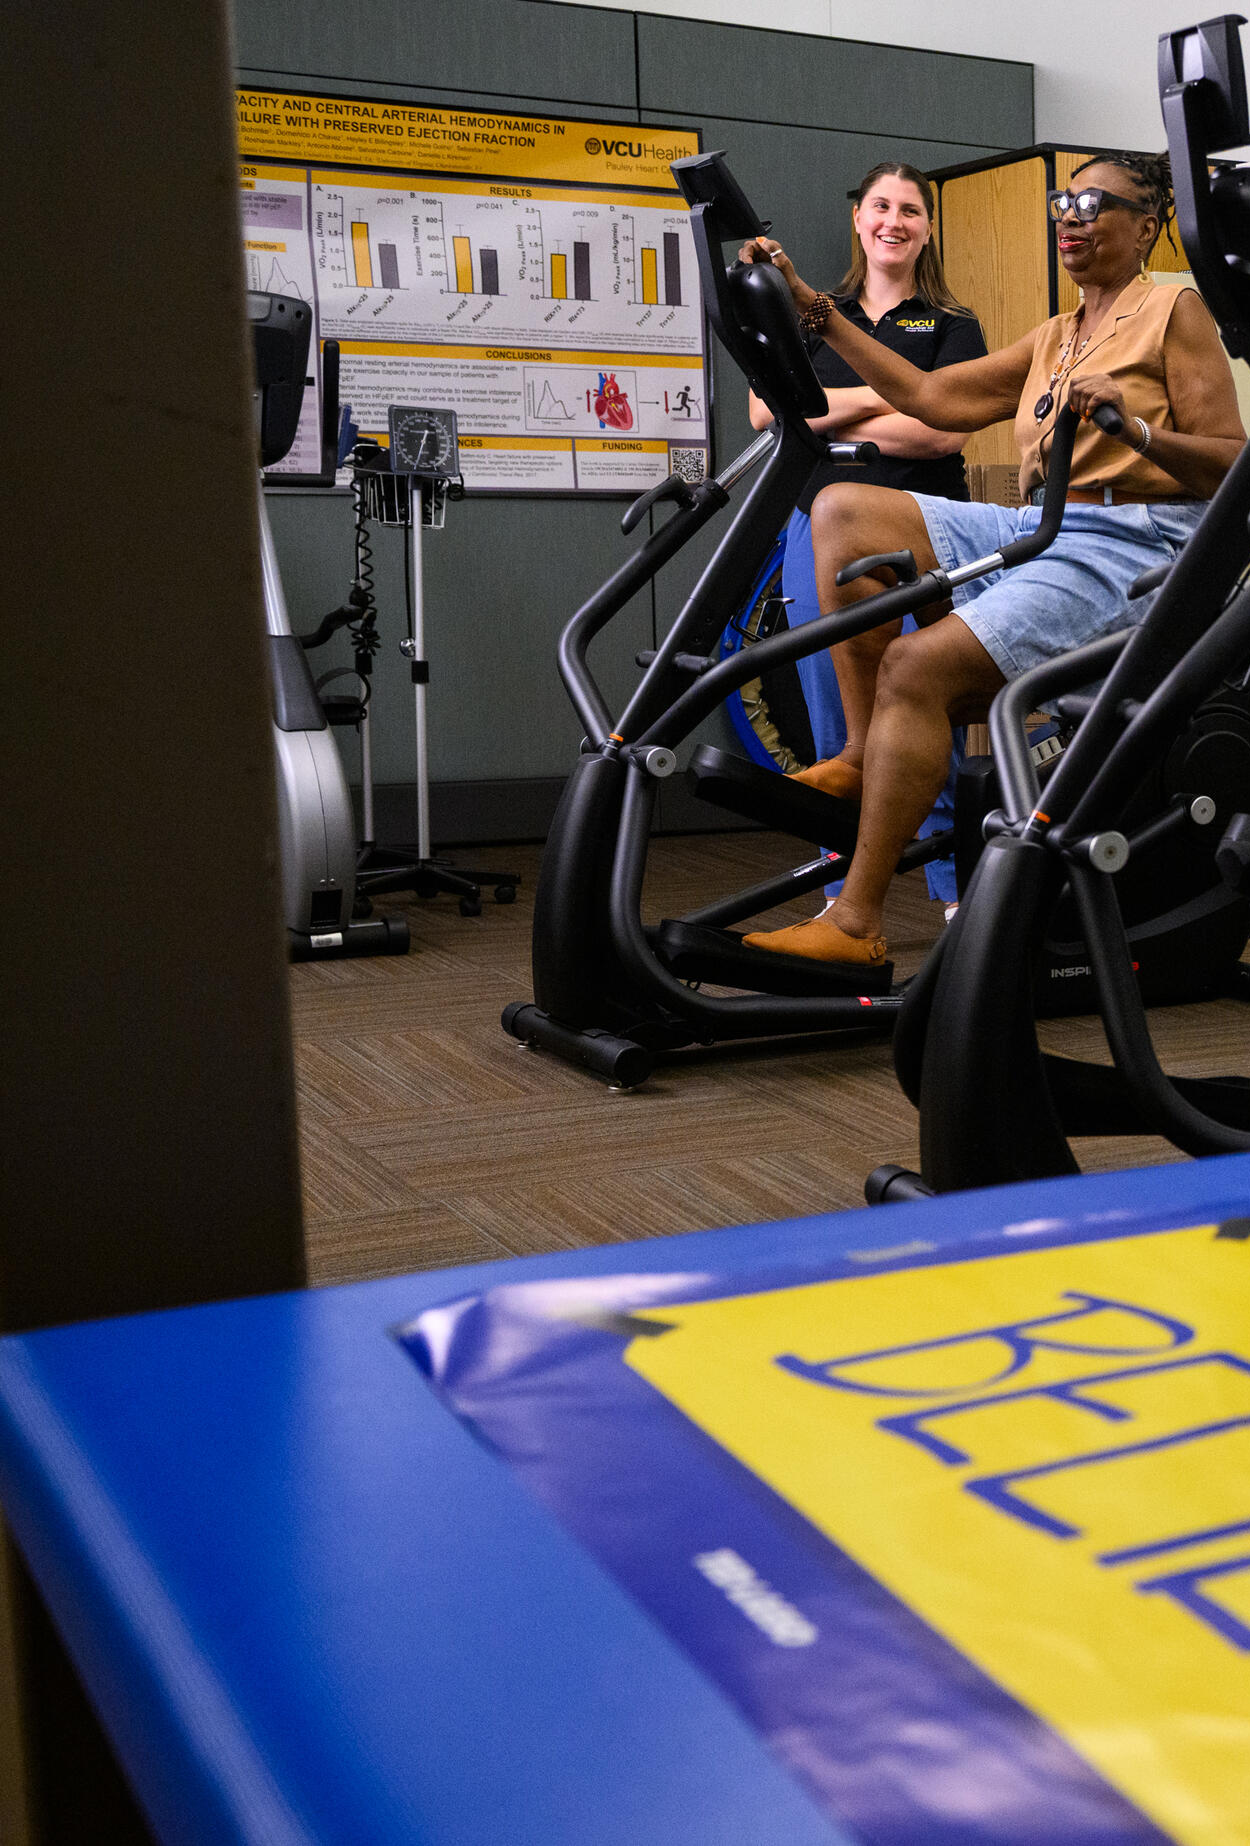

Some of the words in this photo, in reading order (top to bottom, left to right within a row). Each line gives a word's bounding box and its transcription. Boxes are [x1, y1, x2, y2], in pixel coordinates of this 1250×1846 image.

[283, 100, 311, 112] AND
[316, 103, 378, 118] CENTRAL
[382, 109, 446, 125] ARTERIAL
[450, 115, 550, 134] HEMODYNAMICS
[554, 125, 565, 135] IN
[285, 115, 319, 129] WITH
[324, 119, 404, 137] PRESERVED
[408, 127, 470, 143] EJECTION
[474, 133, 536, 147] FRACTION
[606, 162, 633, 174] Pauley
[635, 163, 658, 174] Heart
[490, 186, 532, 198] RESULTS
[908, 319, 935, 327] VCU
[486, 350, 552, 361] CONCLUSIONS
[602, 442, 643, 451] FUNDING
[1051, 966, 1091, 978] INSPI
